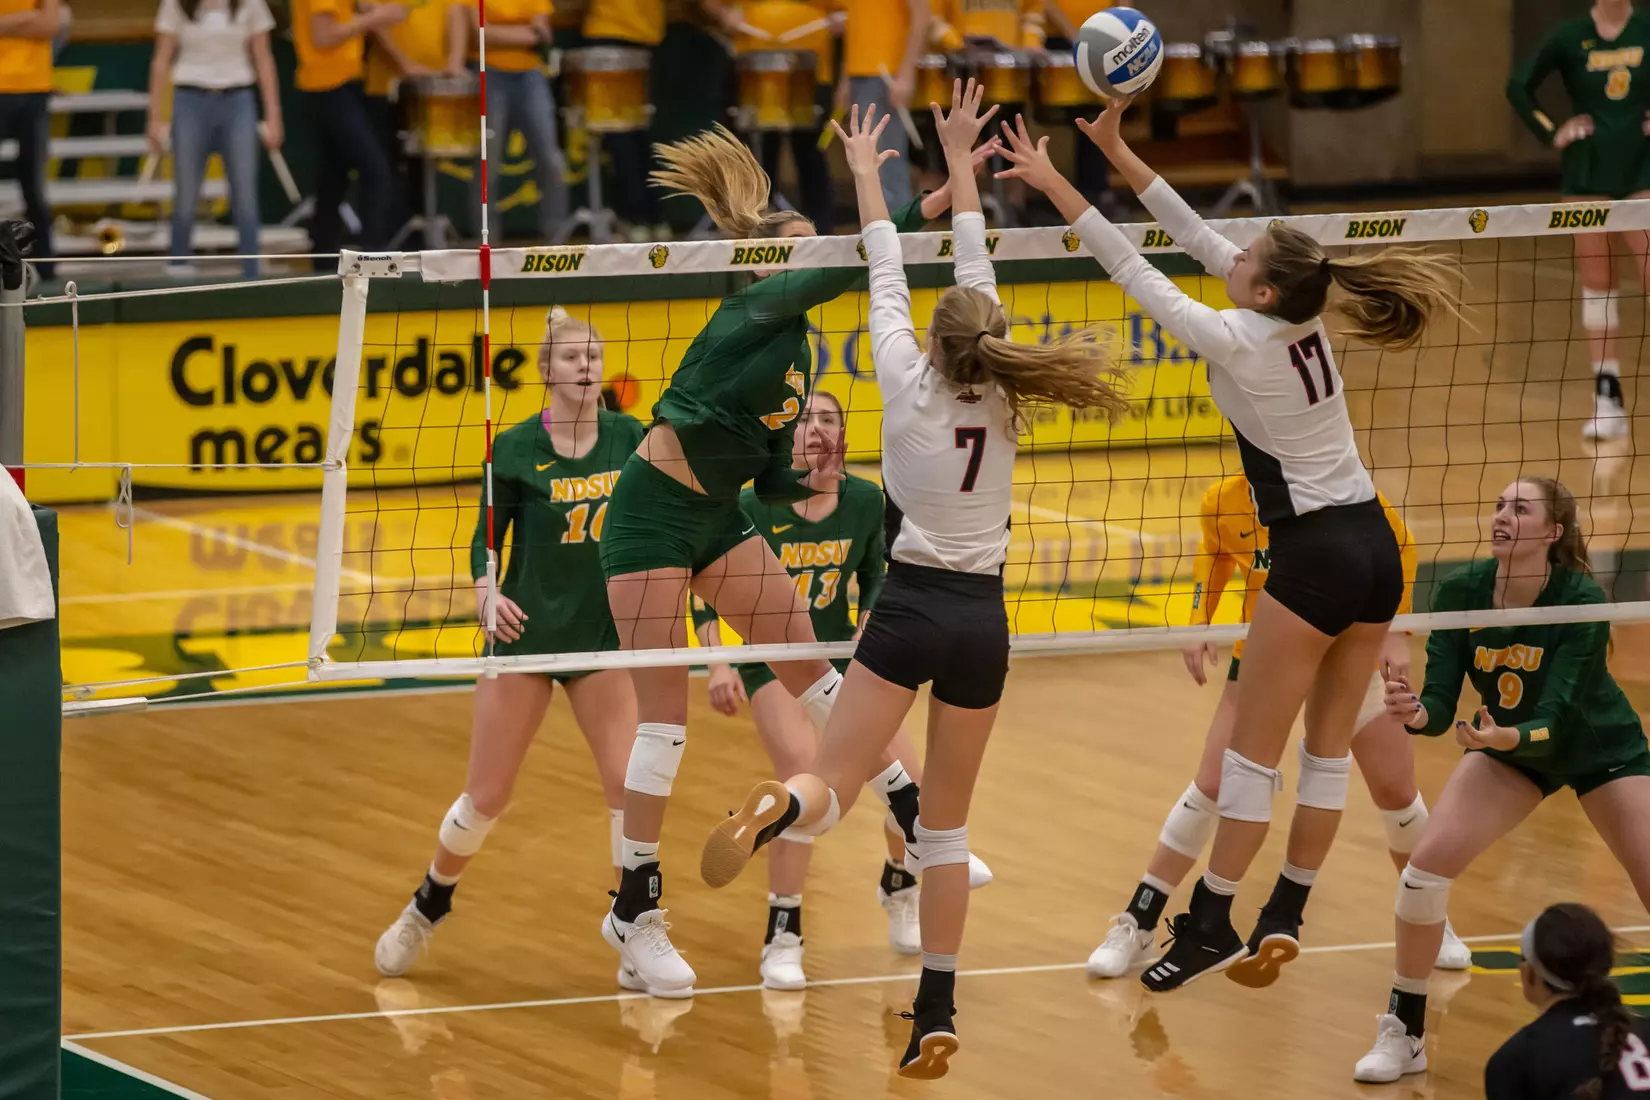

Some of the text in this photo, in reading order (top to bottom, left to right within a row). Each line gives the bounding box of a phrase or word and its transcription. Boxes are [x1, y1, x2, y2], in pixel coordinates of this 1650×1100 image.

[1112, 28, 1151, 66] molten
[1127, 41, 1158, 77] NCAA
[1344, 218, 1407, 239] BISON
[1548, 208, 1611, 229] BISON
[520, 252, 584, 273] BISON
[730, 244, 794, 265] BISON
[1287, 330, 1335, 406] 17
[189, 418, 383, 471] meas
[954, 426, 987, 493] 7
[550, 469, 622, 503] NDSU
[780, 538, 853, 569] NDSU
[792, 568, 842, 610] 13
[1497, 672, 1524, 710] 9
